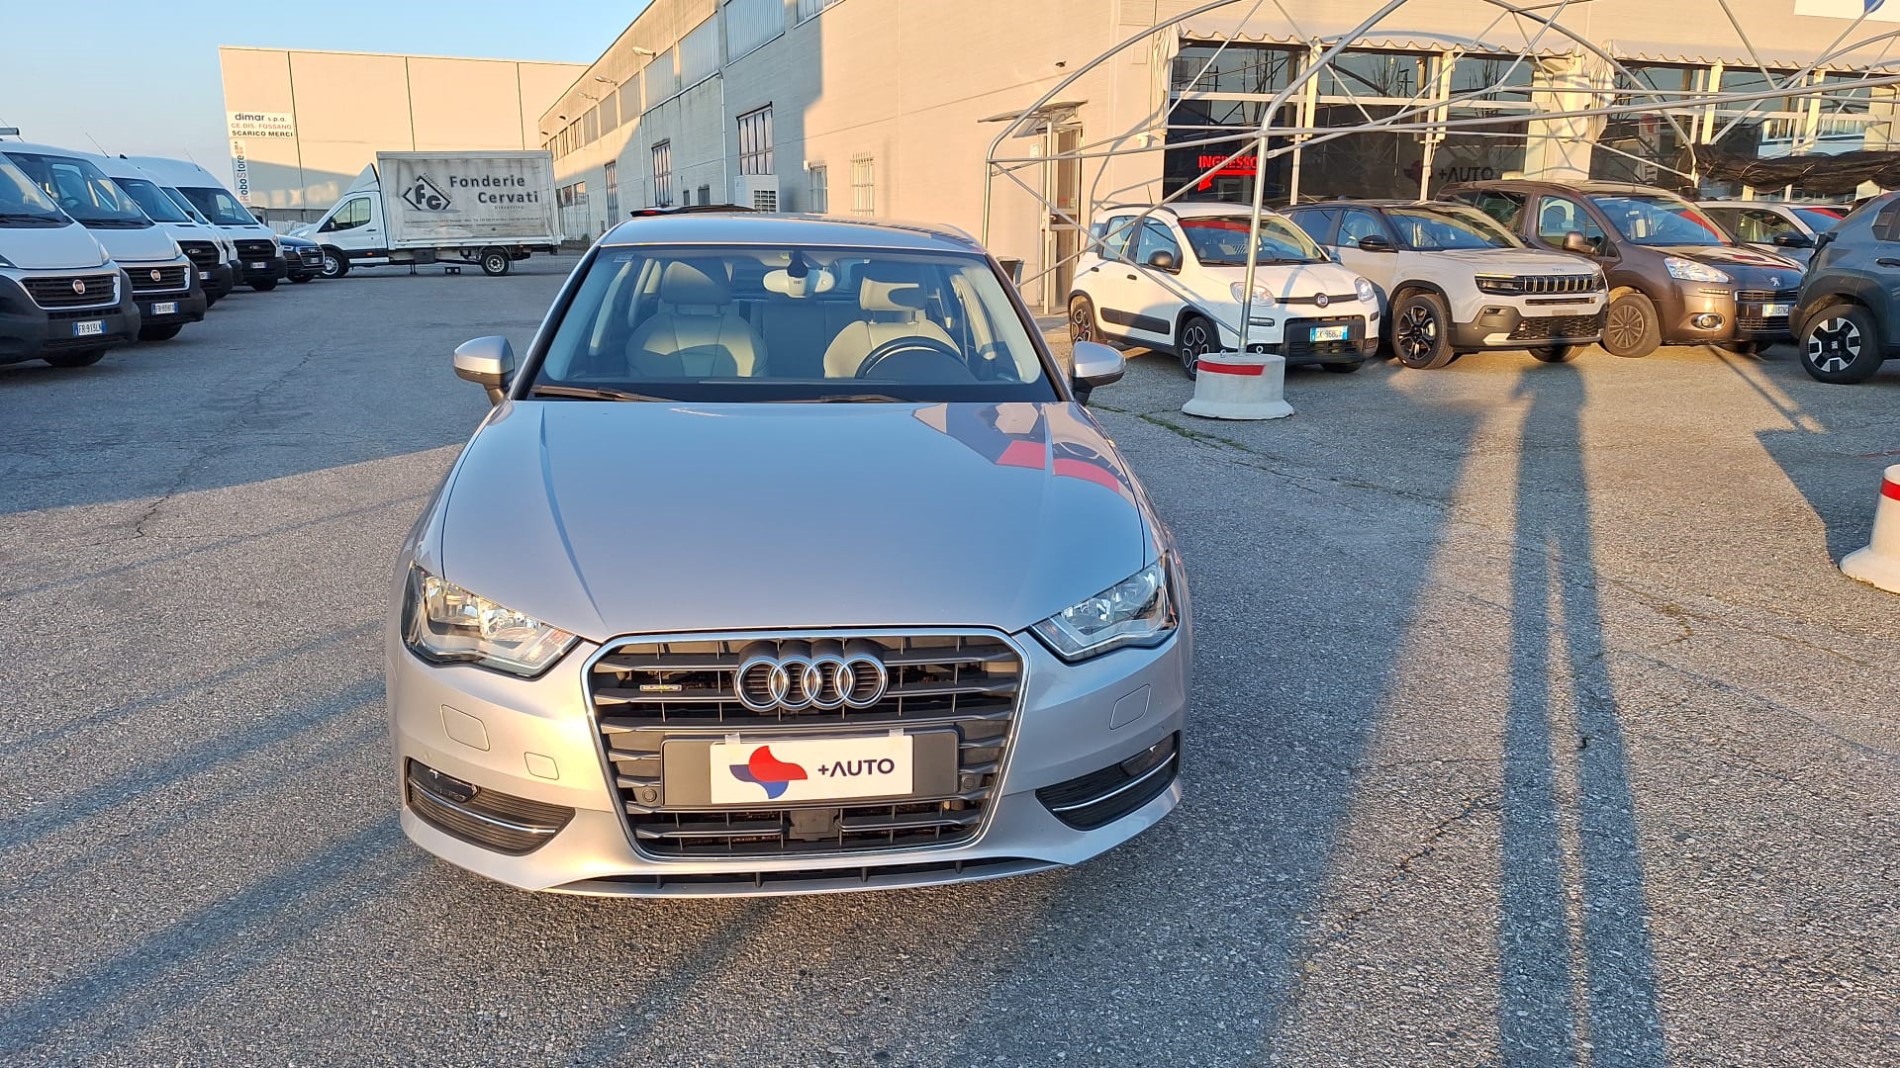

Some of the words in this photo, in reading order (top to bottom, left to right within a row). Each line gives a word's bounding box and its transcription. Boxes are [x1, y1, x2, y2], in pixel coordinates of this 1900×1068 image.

[234, 113, 265, 121] dimar
[237, 154, 249, 202] RoboStore
[450, 174, 525, 188] Fonderie
[478, 190, 539, 204] Cervati
